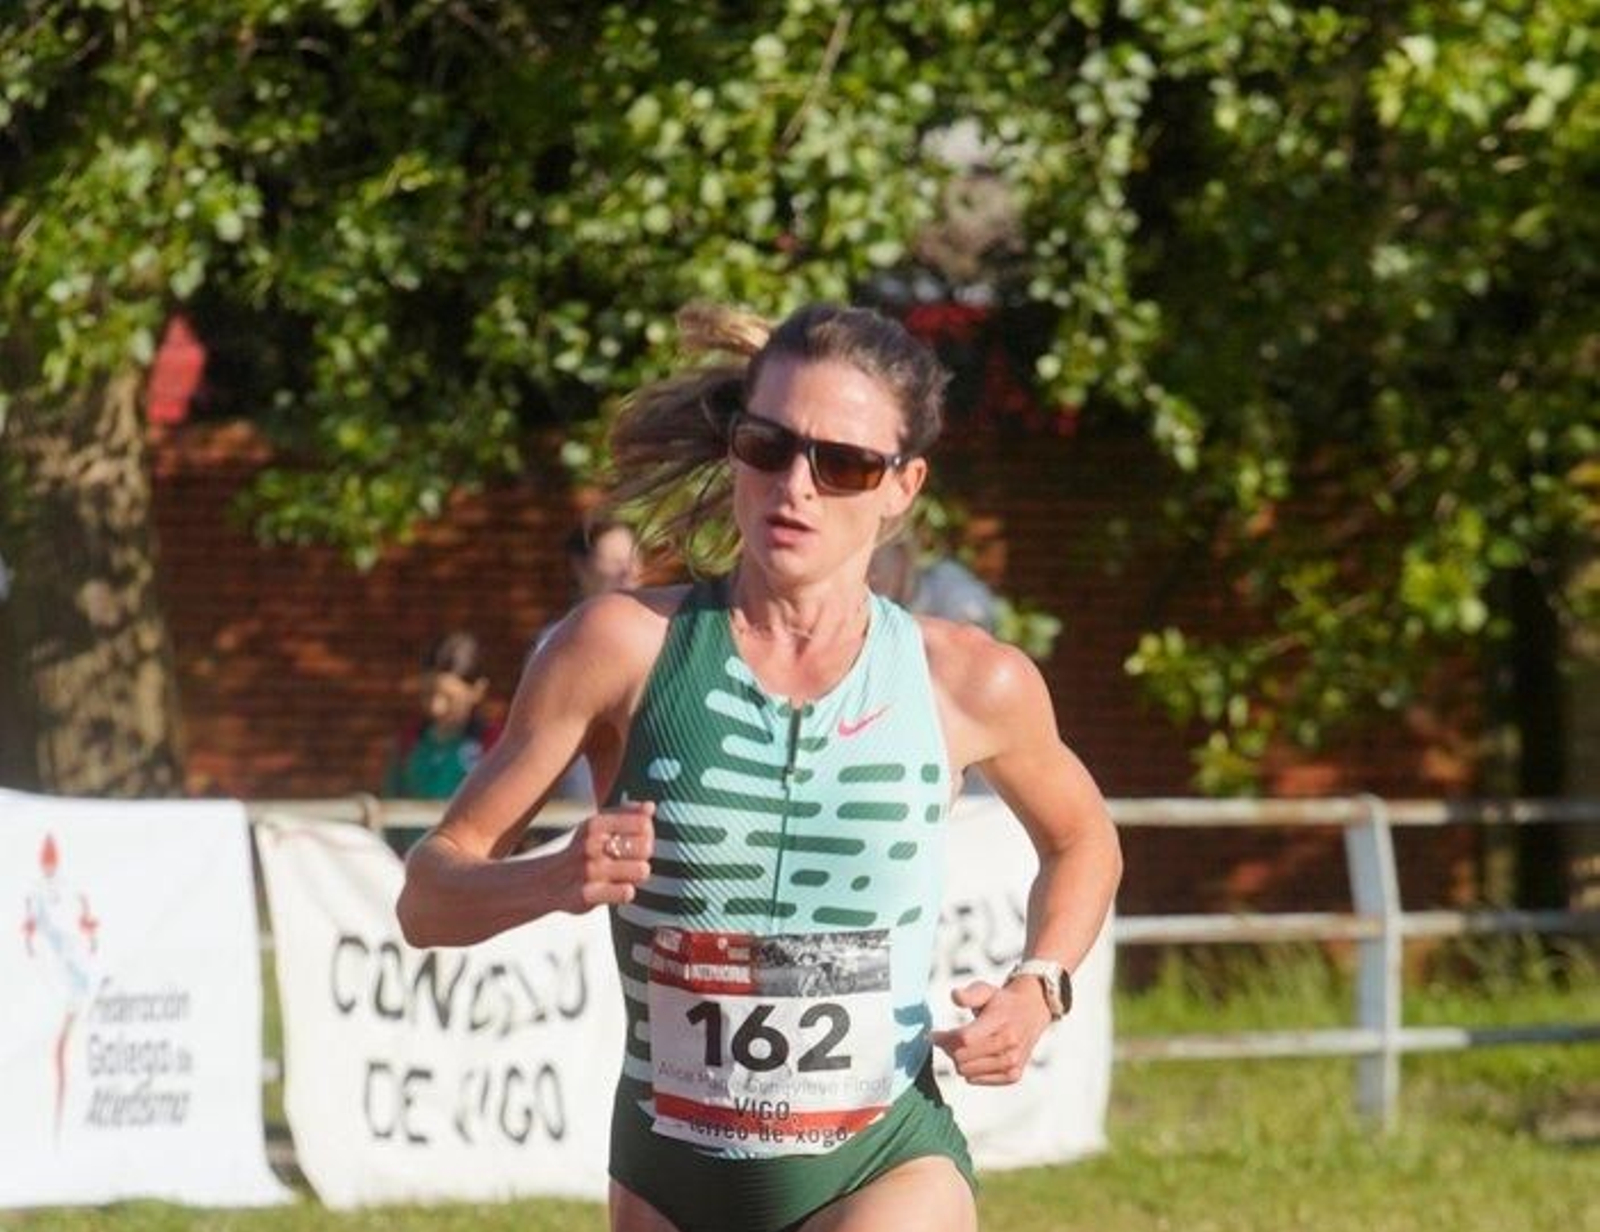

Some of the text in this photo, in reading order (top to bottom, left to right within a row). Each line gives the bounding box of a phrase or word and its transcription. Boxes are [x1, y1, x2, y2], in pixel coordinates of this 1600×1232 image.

[686, 1001, 852, 1073] 162
[364, 1060, 433, 1144] DE
[759, 1123, 784, 1143] de
[796, 1126, 848, 1148] xogo
